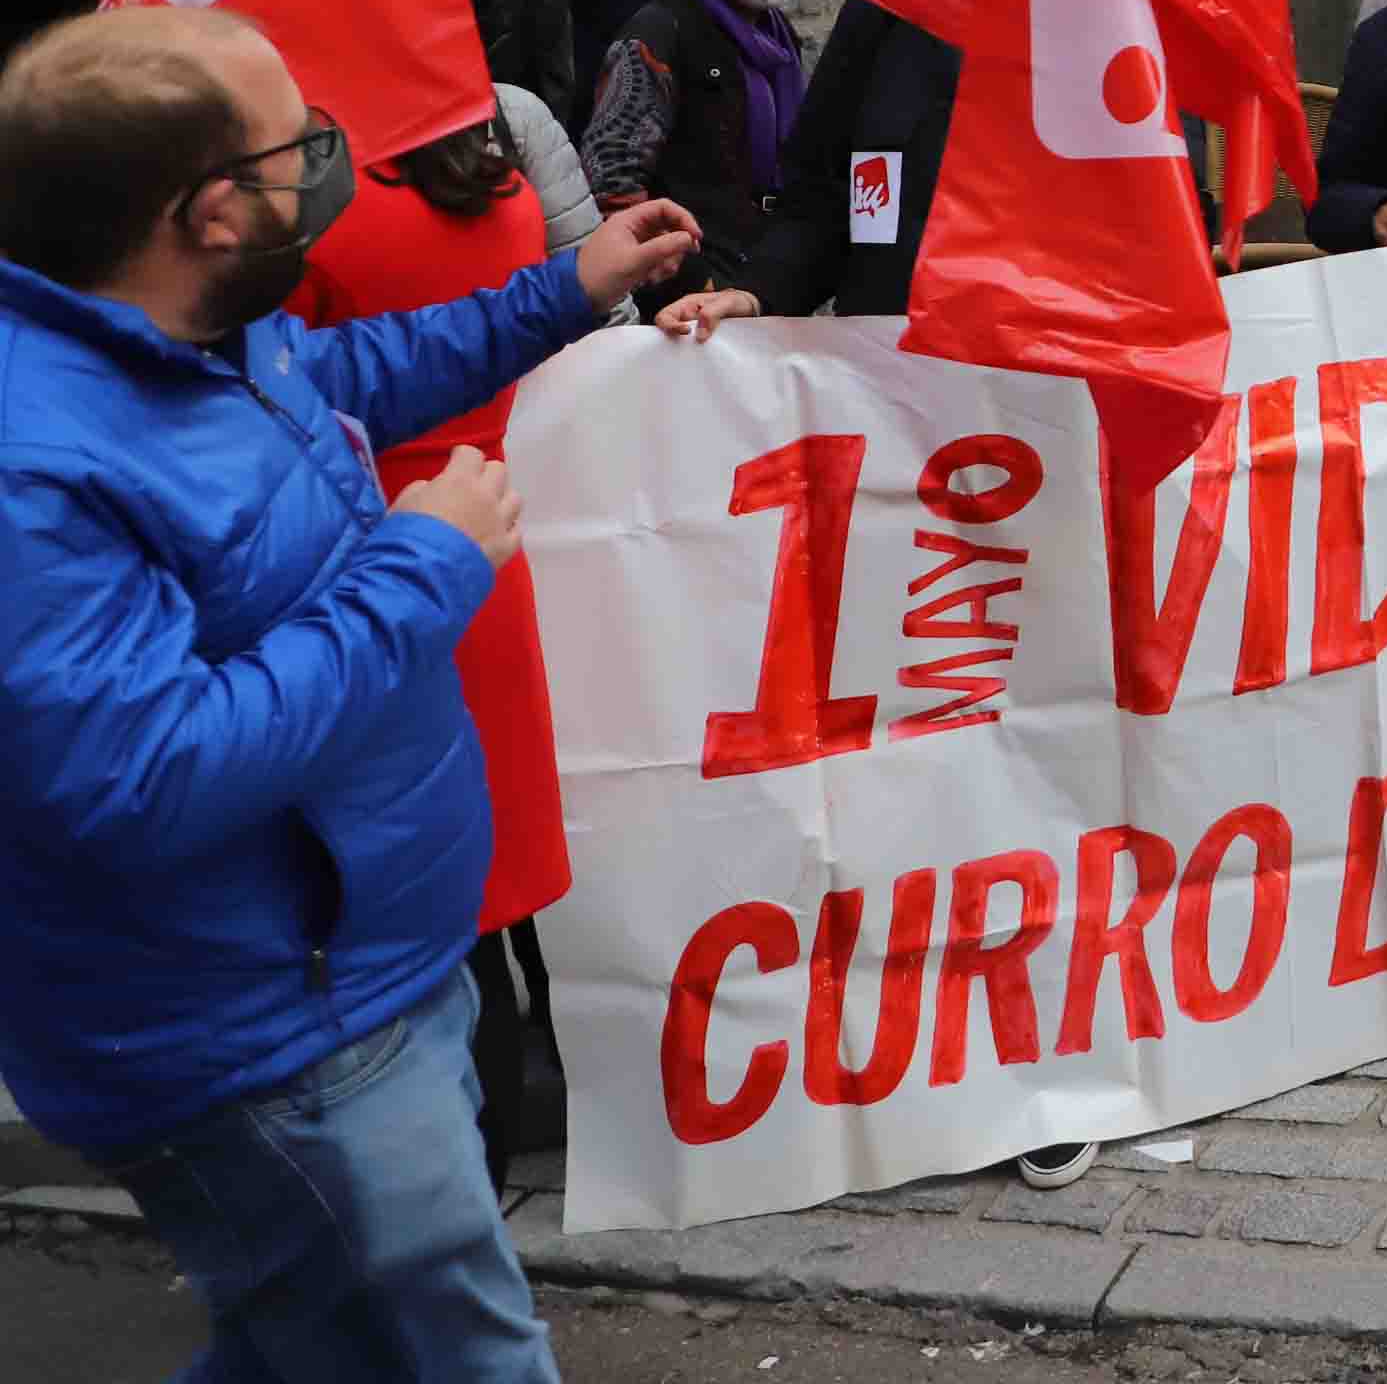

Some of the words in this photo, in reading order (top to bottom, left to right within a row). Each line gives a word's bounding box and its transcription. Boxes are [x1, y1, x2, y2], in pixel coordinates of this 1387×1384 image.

[701, 433, 878, 780] 1
[886, 432, 1044, 741] MAYO
[660, 803, 1293, 1146] CURRO
